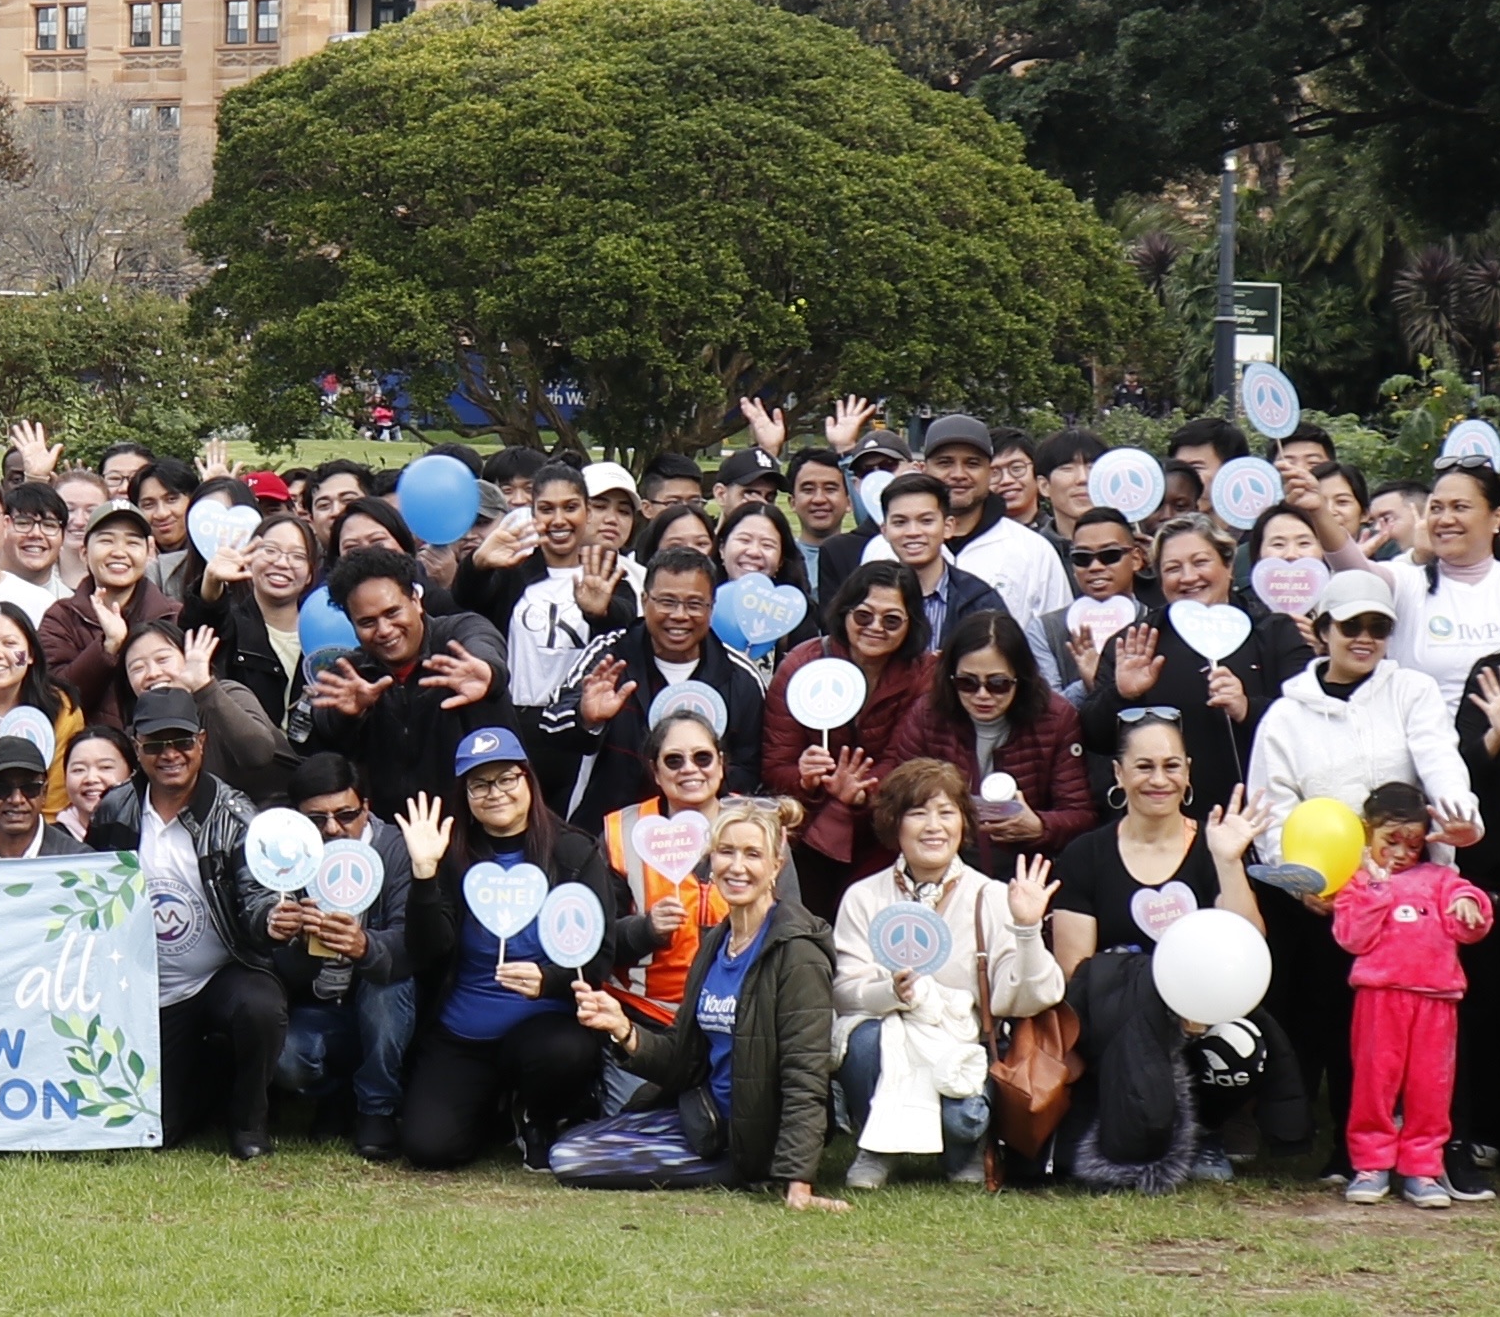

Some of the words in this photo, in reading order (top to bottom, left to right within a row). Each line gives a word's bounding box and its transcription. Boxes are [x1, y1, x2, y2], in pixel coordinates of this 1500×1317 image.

[742, 595, 792, 624] ONE!
[654, 823, 687, 835] PEACE
[651, 839, 672, 850] FOR
[673, 837, 693, 847] ALL
[477, 887, 536, 905] ONE!
[15, 931, 102, 1015] all
[704, 995, 736, 1014] Youth
